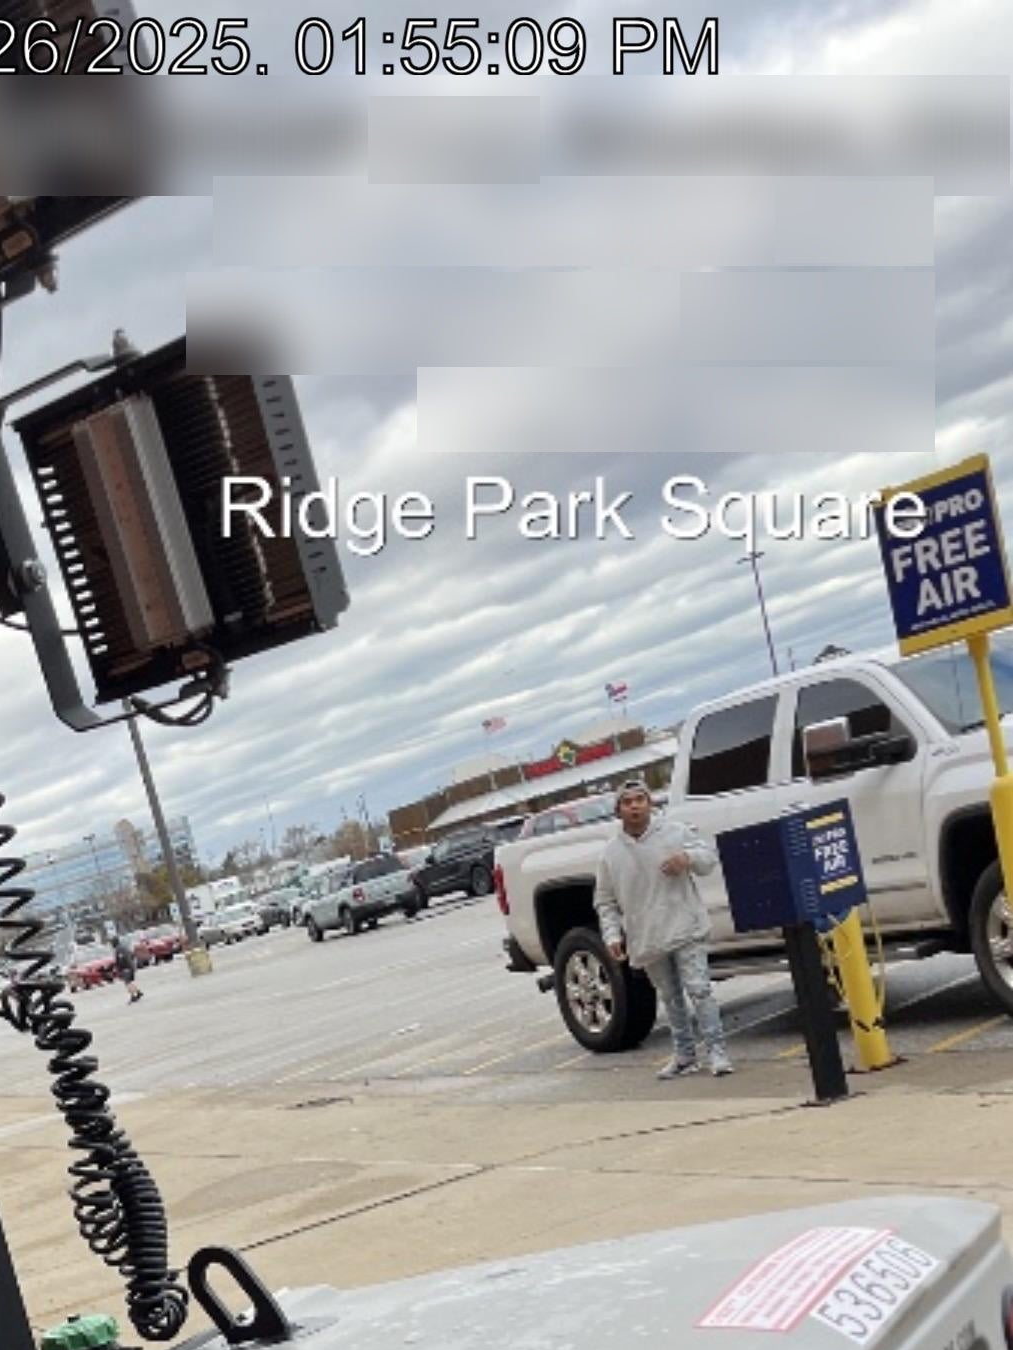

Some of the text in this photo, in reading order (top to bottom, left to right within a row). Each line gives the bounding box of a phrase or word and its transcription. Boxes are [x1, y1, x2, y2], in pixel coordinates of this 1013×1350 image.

[891, 519, 991, 583] FREE
[916, 566, 982, 616] AIR
[818, 1239, 933, 1338] 536506
